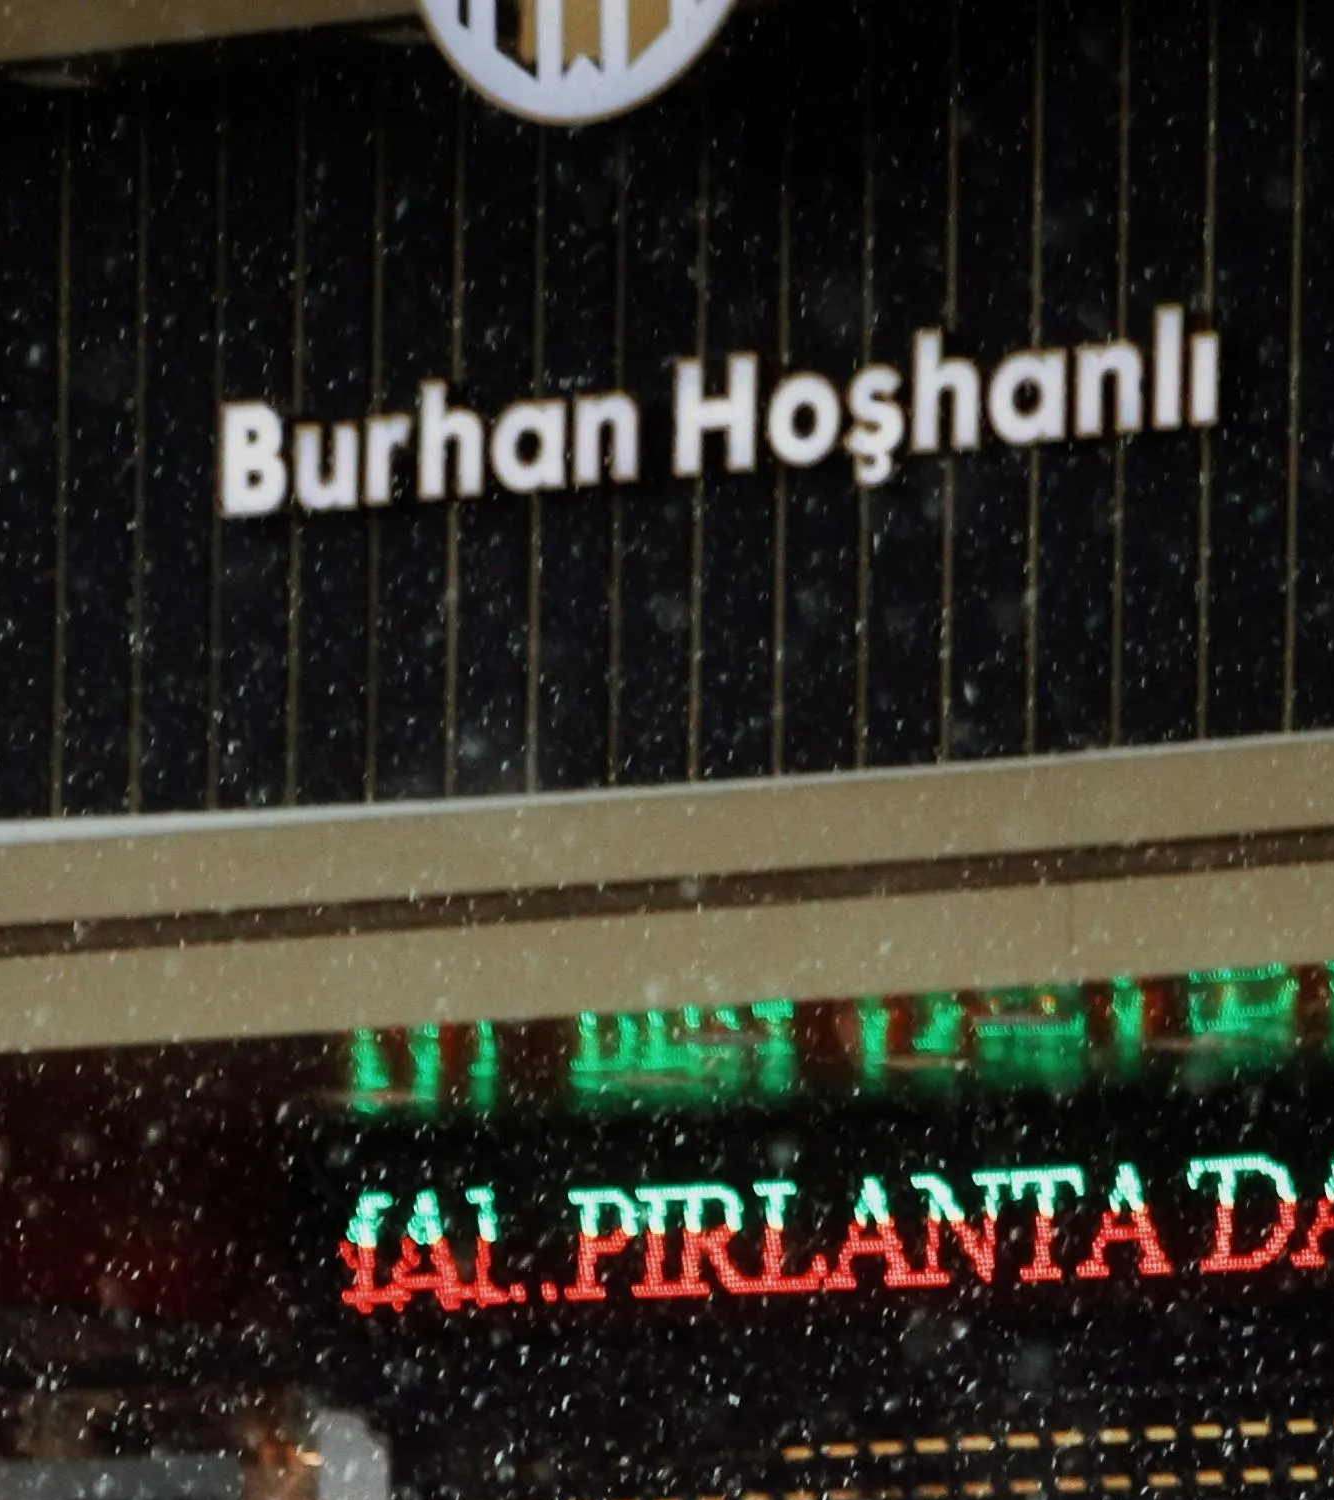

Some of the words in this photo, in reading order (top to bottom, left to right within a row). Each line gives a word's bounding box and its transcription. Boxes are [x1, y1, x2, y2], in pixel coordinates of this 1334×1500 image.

[219, 379, 640, 518] Burhan
[672, 302, 1220, 485] Hoşhanlı
[564, 1164, 1173, 1300] PIRLANTA
